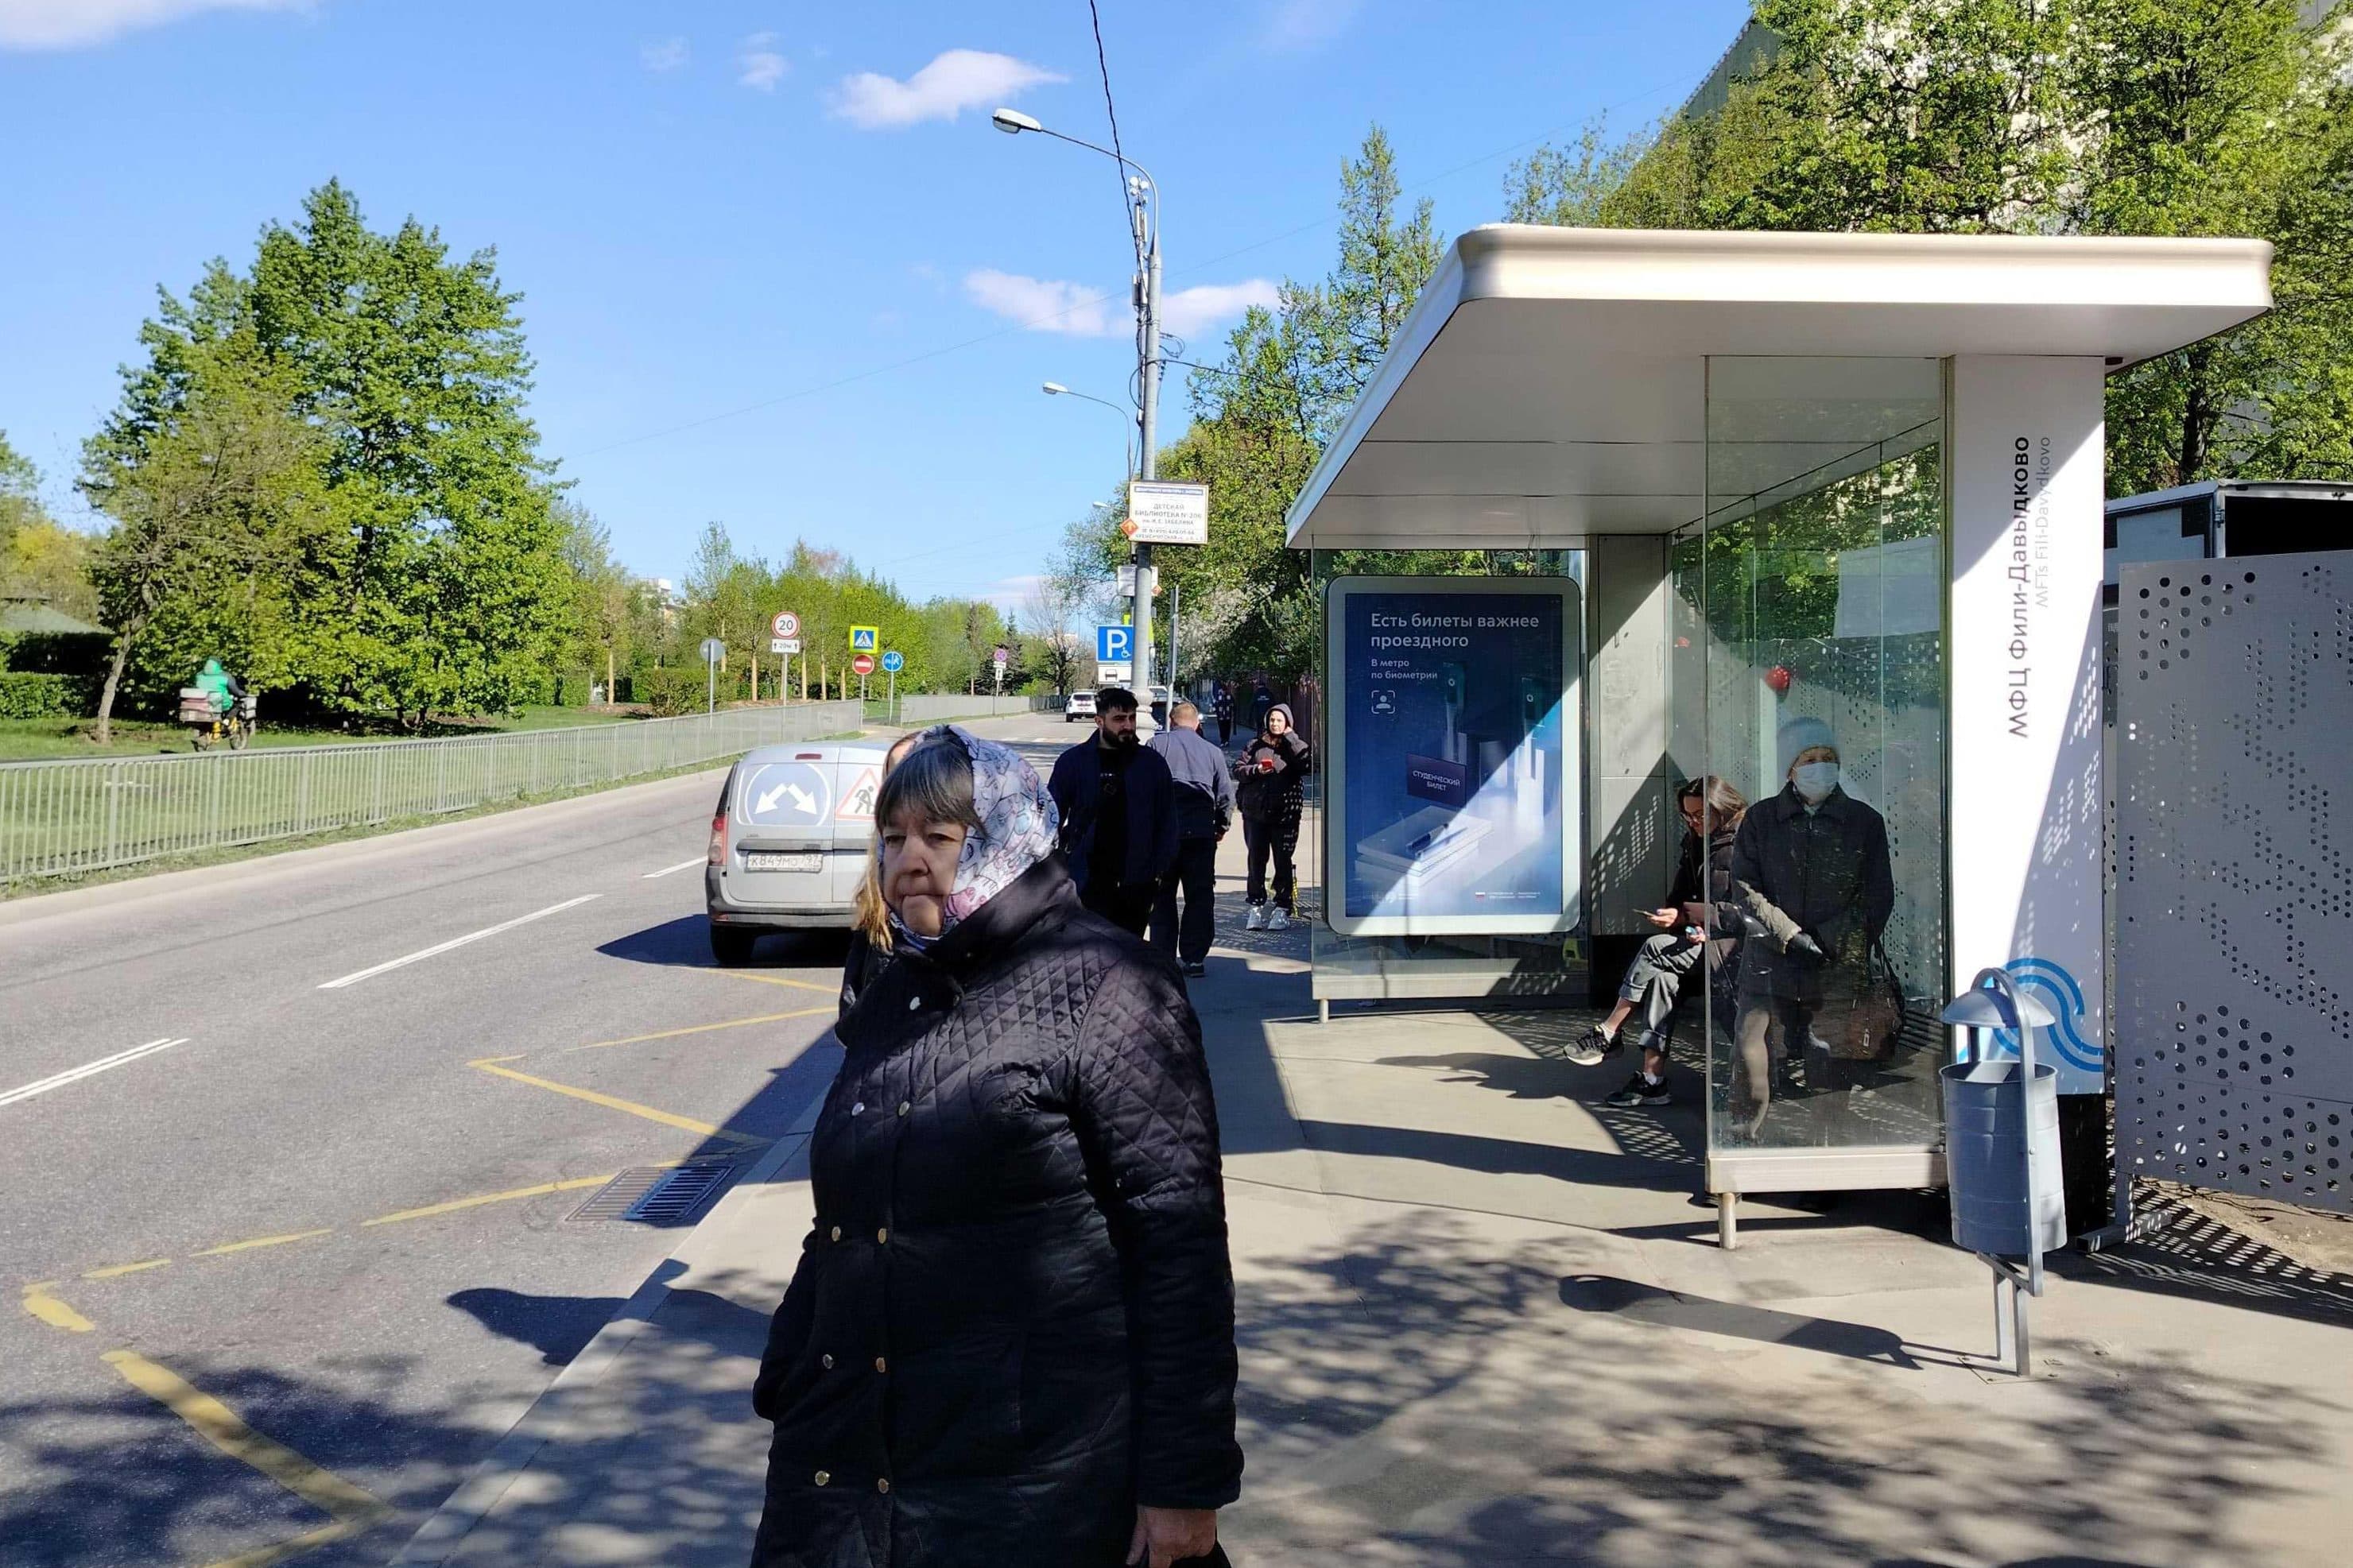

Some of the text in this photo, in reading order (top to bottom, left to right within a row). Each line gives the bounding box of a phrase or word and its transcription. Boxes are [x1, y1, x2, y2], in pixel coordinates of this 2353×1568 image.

[1134, 509, 1180, 518] БИБЛИОТЕКА
[2035, 436, 2052, 608] MFTs Fili-Davydkovo
[2008, 436, 2031, 738] МФЦ Фили-Давыдково
[778, 620, 793, 630] 20
[1370, 613, 1540, 628] Есть билеты важнее
[1370, 637, 1469, 649] проездного
[1380, 660, 1409, 669] метро
[1385, 671, 1437, 681] биометрии
[1413, 769, 1461, 787] СТУДЕНЧЕСКИЙ
